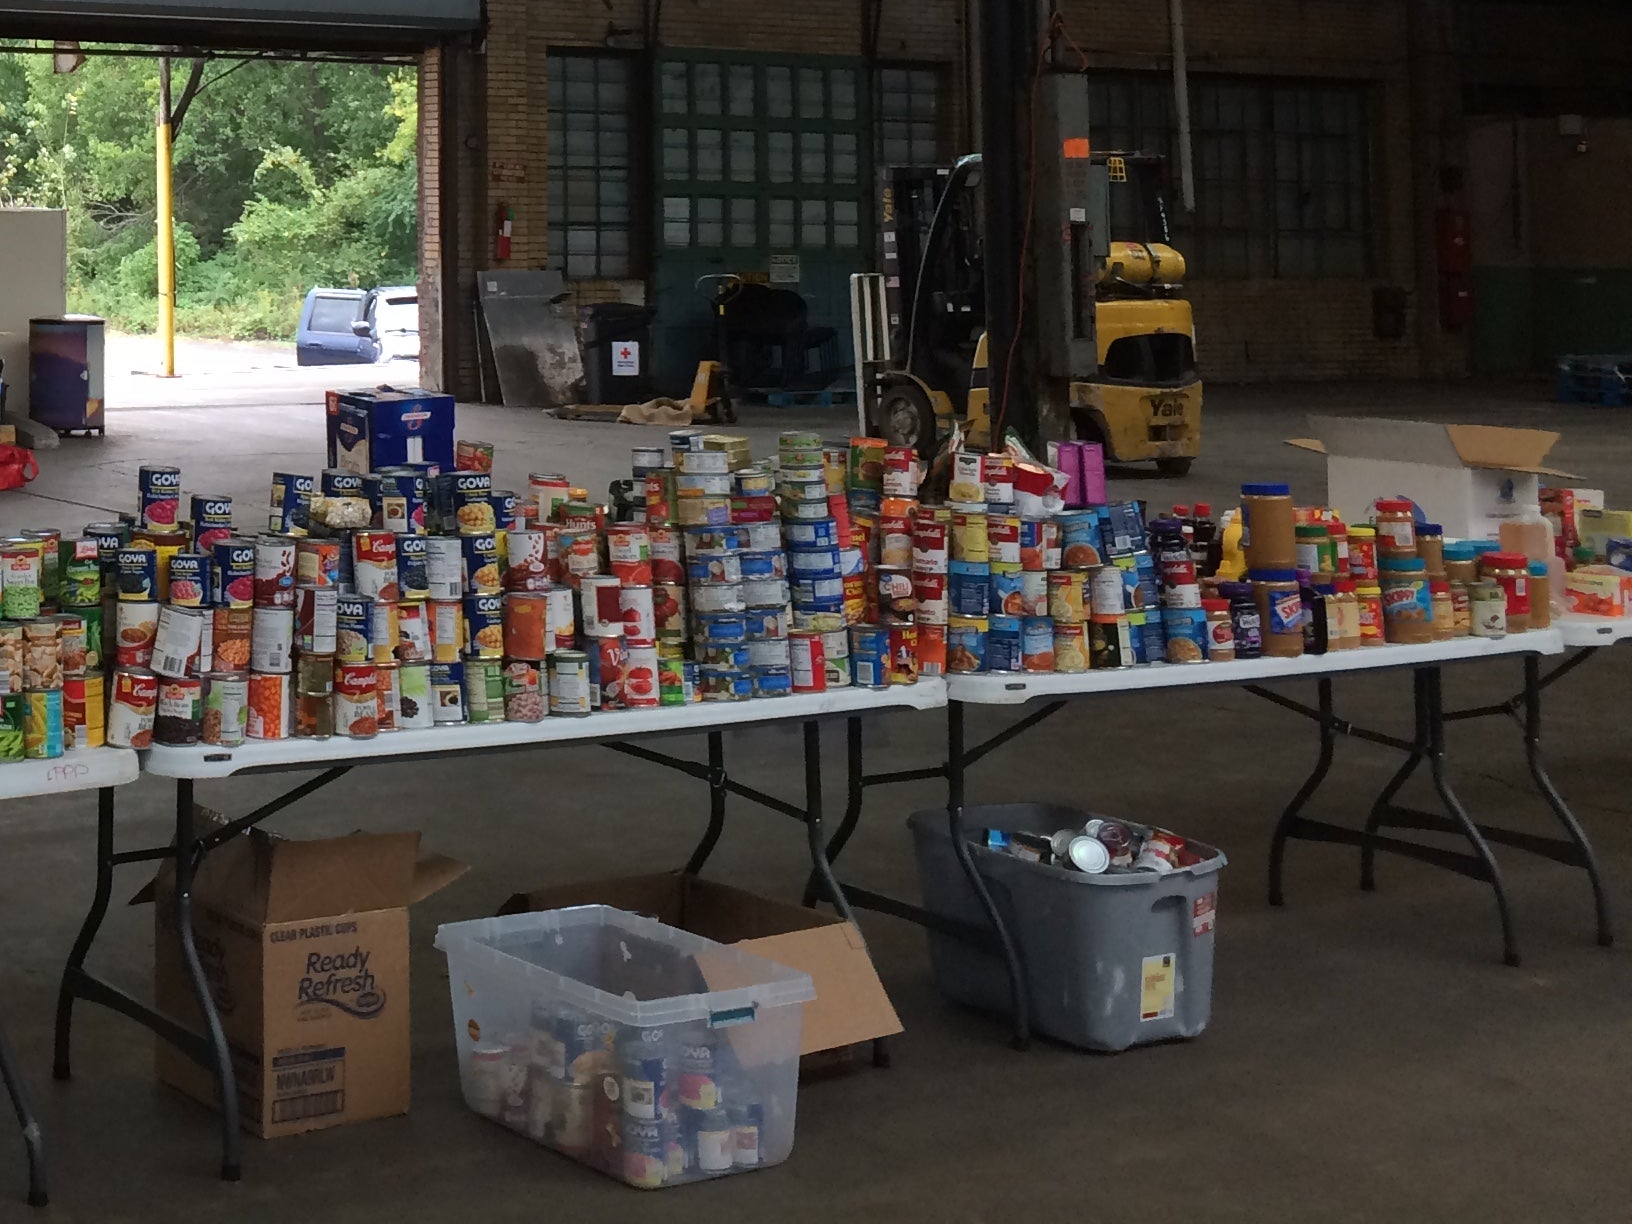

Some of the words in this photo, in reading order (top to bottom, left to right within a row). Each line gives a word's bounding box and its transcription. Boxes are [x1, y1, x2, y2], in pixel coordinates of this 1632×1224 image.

[882, 187, 894, 223] Yale
[1150, 399, 1184, 417] Yale
[457, 477, 491, 489] GOYA
[119, 554, 147, 563] GOYA
[171, 560, 199, 569] GOYA
[337, 603, 364, 615] OYA
[270, 930, 297, 944] CLEAR
[299, 926, 333, 939] PLASTIC
[335, 922, 358, 934] CUPS
[306, 945, 371, 974] Ready
[298, 969, 376, 1000] Refresh
